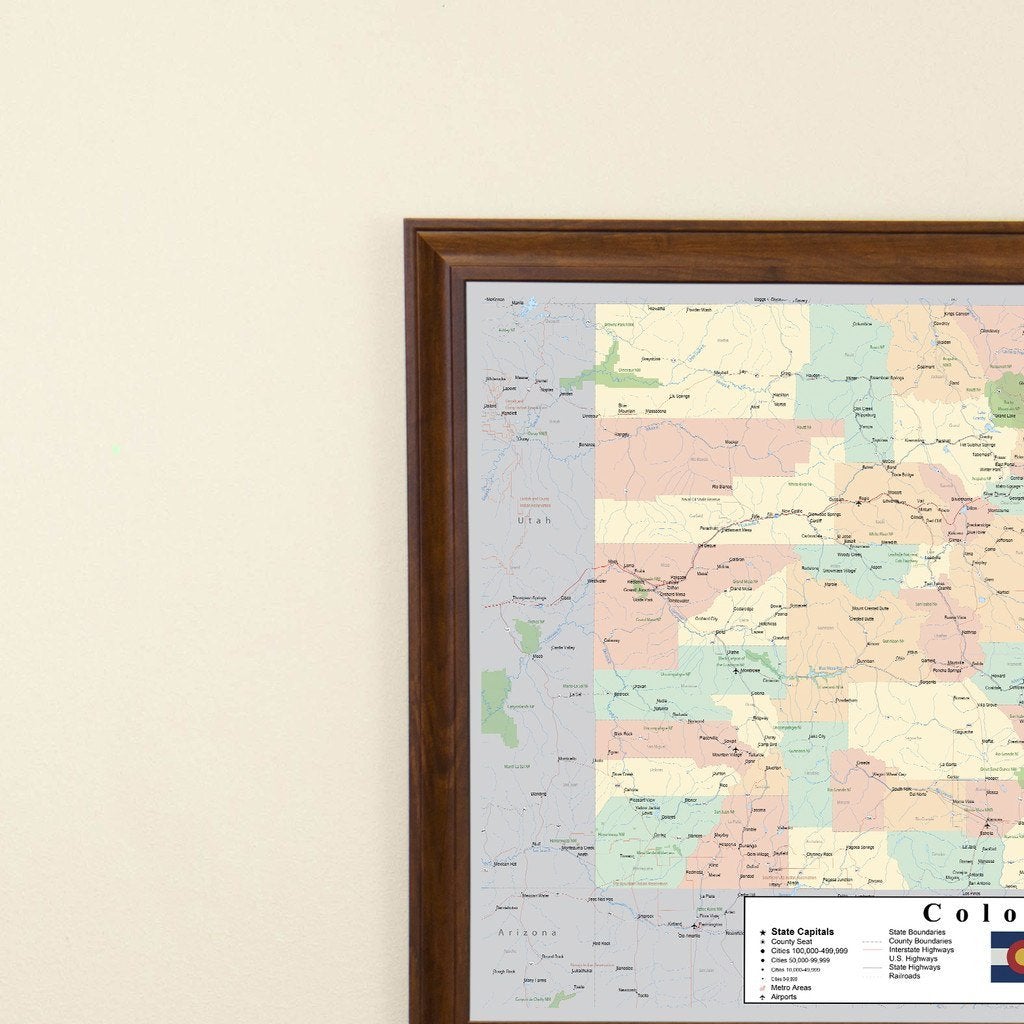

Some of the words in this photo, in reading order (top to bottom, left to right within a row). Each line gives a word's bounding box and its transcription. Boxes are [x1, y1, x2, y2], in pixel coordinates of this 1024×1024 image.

[498, 928, 557, 936] Arizona
[772, 927, 795, 936] State
[797, 927, 834, 938] Capitals
[889, 928, 906, 936] State
[908, 928, 946, 936] Boundaries
[771, 938, 795, 947] County
[797, 937, 812, 946] Seat
[889, 936, 912, 946] County
[915, 937, 952, 945] Boundaries
[771, 947, 790, 955] Cities
[792, 947, 848, 955] 100,000-499,999
[889, 946, 920, 954] Interstate
[922, 946, 954, 955] Highways
[771, 956, 787, 964] Cities
[889, 954, 903, 962] U.S.
[906, 955, 938, 964] Highways
[889, 963, 906, 971] State
[908, 963, 940, 972] Highways
[889, 972, 920, 980] Railroads
[792, 984, 811, 992] Areas
[771, 993, 797, 1002] Airports
